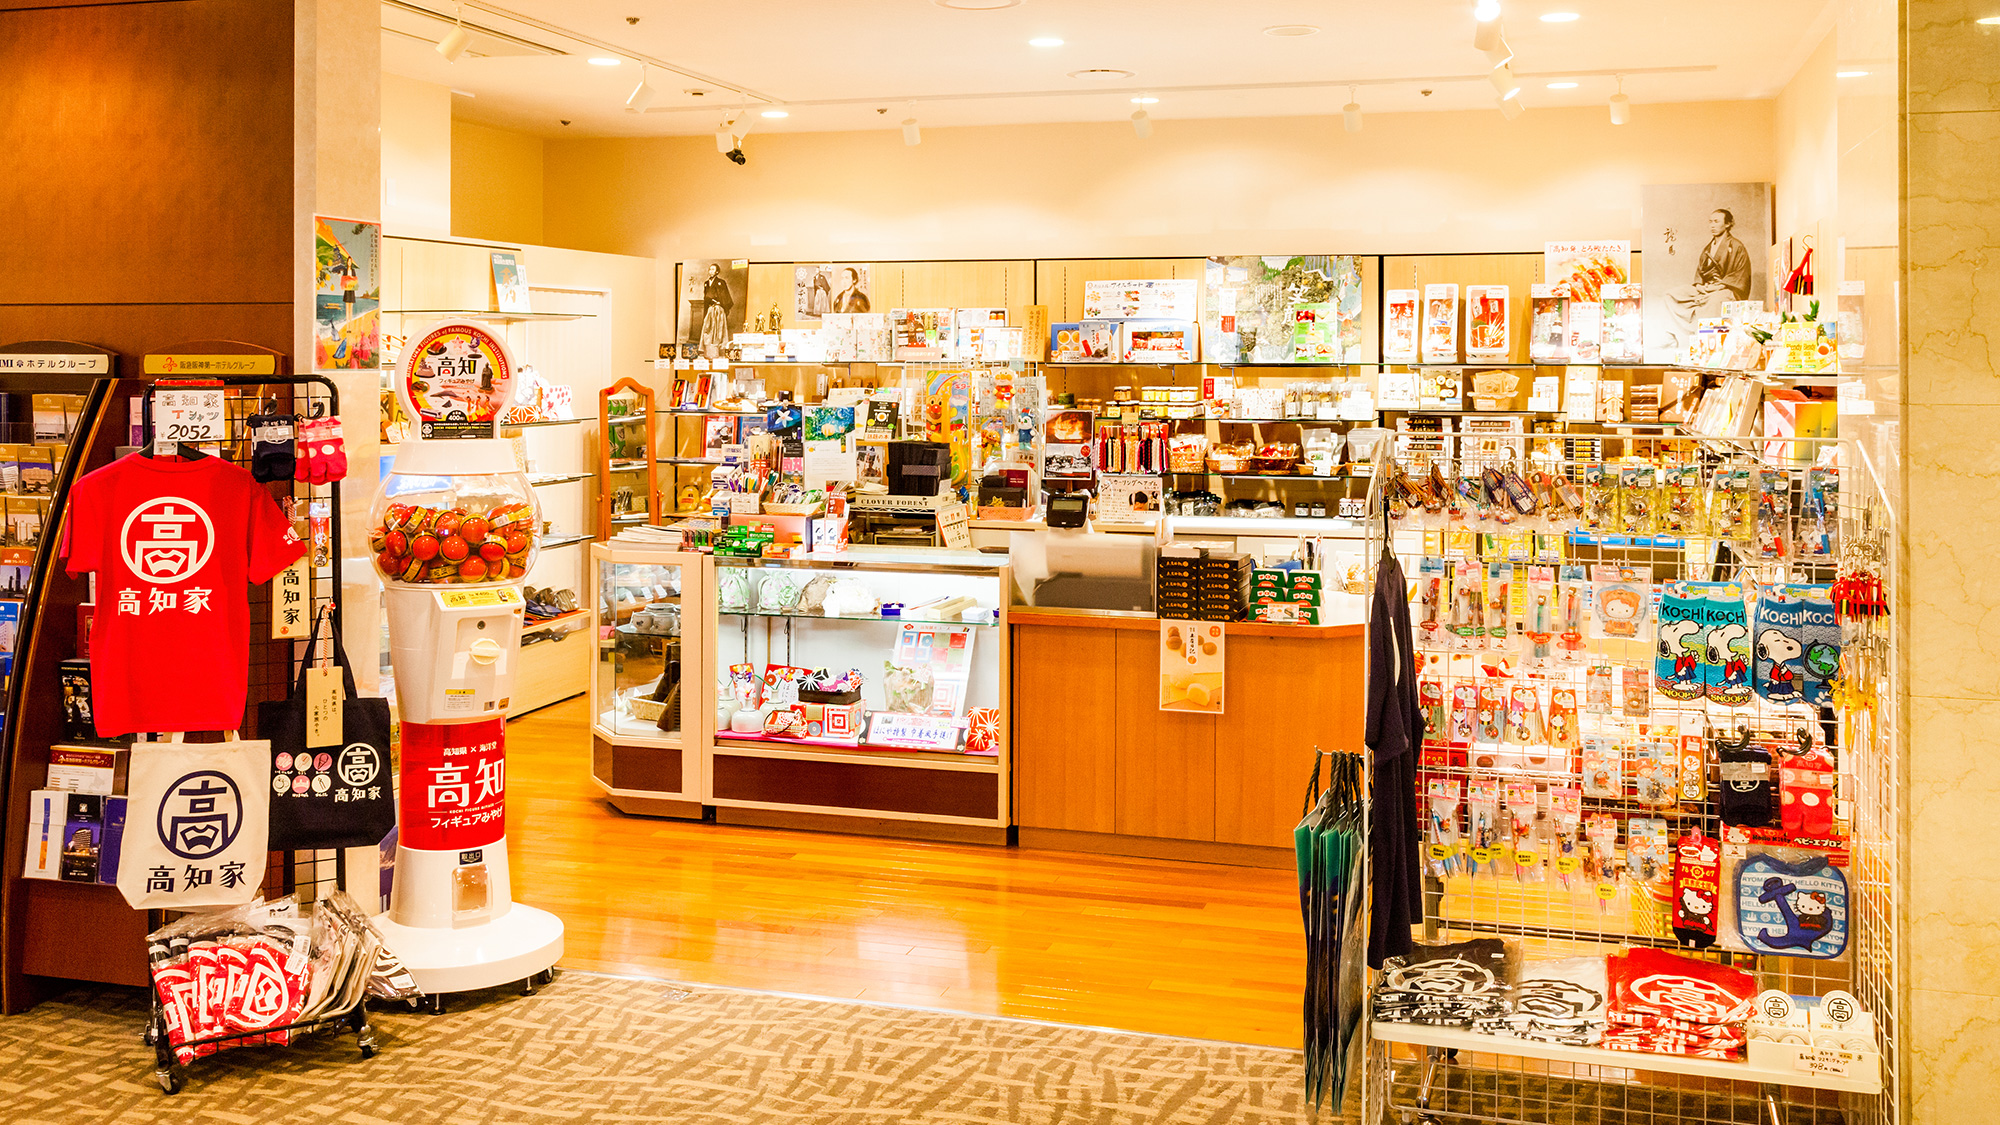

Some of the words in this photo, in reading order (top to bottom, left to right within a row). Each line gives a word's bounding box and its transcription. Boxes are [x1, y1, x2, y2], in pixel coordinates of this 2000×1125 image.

[447, 327, 472, 335] FAMOUS
[472, 330, 490, 344] KOCHI
[27, 359, 97, 369] ホテルグループ
[437, 356, 477, 377] 高知
[161, 392, 220, 409] 高知家
[117, 586, 213, 616] 高知家
[1662, 603, 1704, 620] KOCHI
[1760, 606, 1802, 625] KOCHI
[1659, 686, 1696, 699] SNOOPY
[1710, 693, 1749, 703] SNOOPY
[443, 746, 468, 757] 高知県
[479, 741, 498, 753] 海洋堂
[427, 758, 505, 808] 高知
[334, 785, 382, 803] 高知家
[430, 806, 503, 829] フィギュアみやげ
[1752, 834, 1771, 842] Hello
[1794, 837, 1843, 848] ベビーエプロン
[145, 860, 247, 894] 高知家
[1795, 879, 1820, 887] HELLO
[1820, 880, 1844, 890] KITTY
